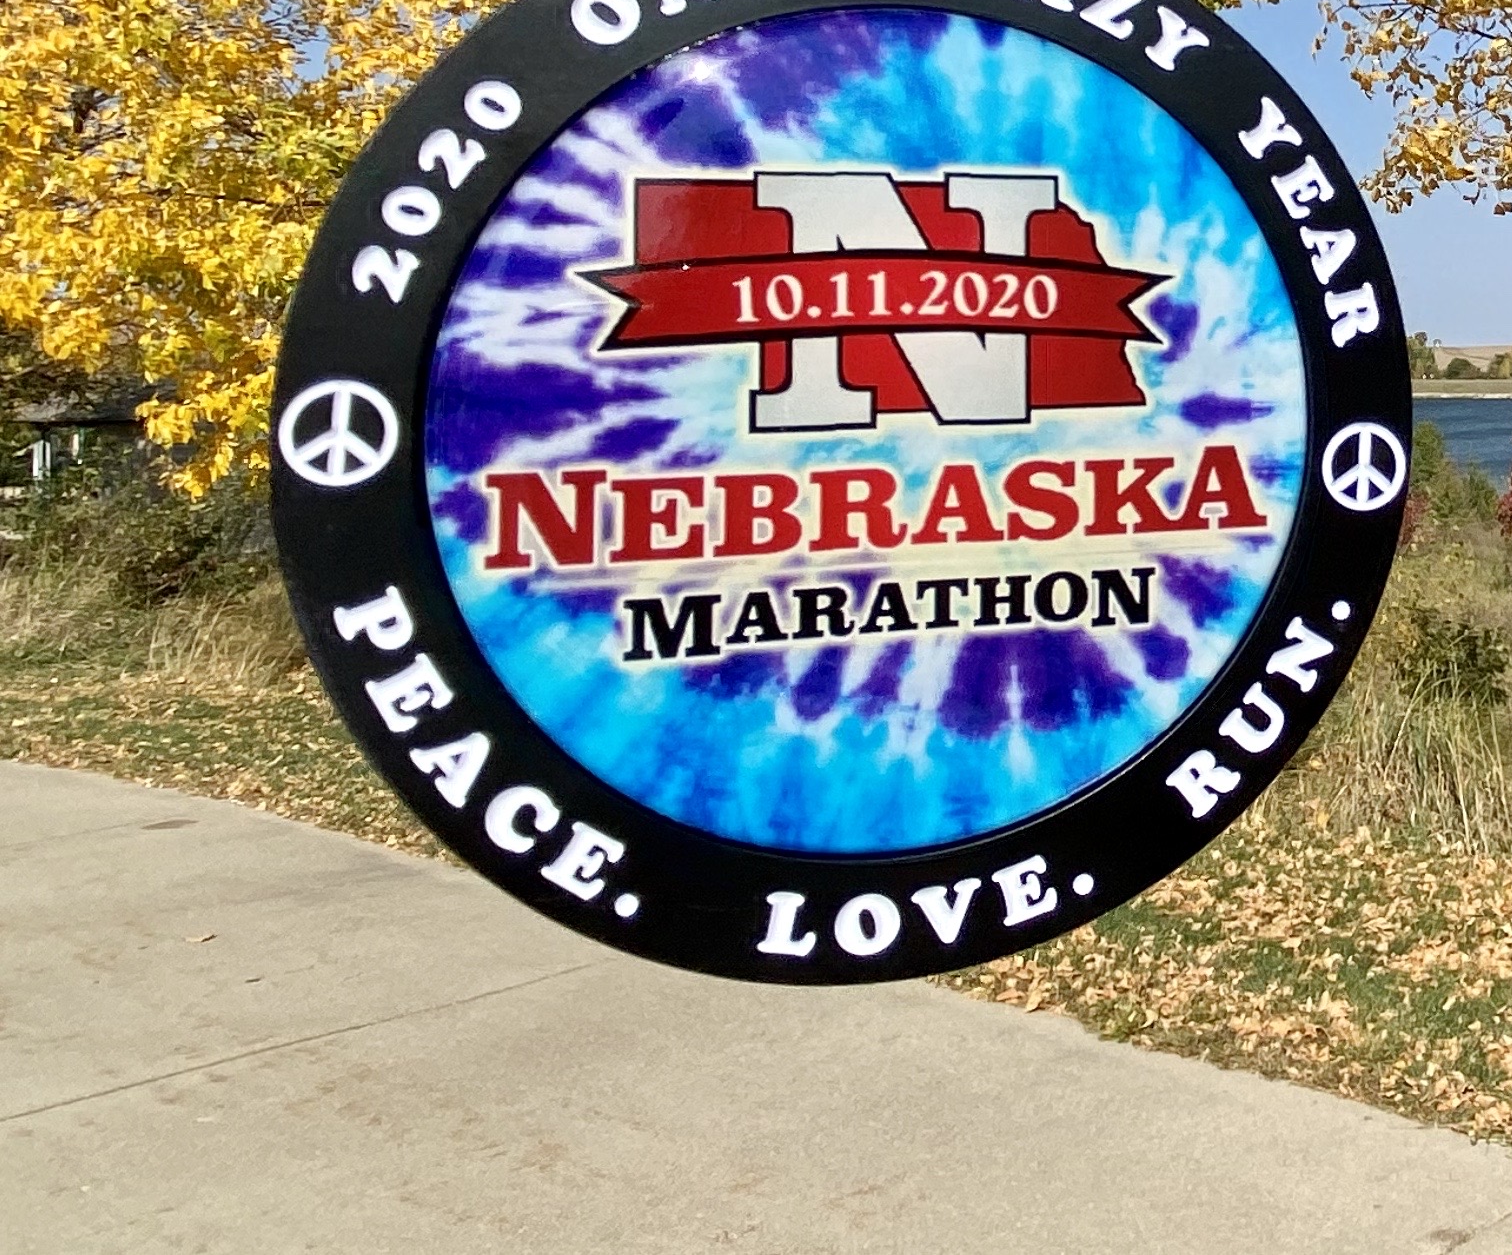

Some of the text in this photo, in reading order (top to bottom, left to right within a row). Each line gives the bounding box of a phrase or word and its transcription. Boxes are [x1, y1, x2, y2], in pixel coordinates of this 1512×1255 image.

[351, 80, 523, 303] 2020
[1238, 96, 1382, 348] YEAR
[732, 270, 1059, 322] 10.11.2020
[484, 445, 1268, 571] NEBRASKA
[622, 567, 1156, 662] MARATHON
[333, 585, 1352, 959] PEACE. LOVE. RUN.
